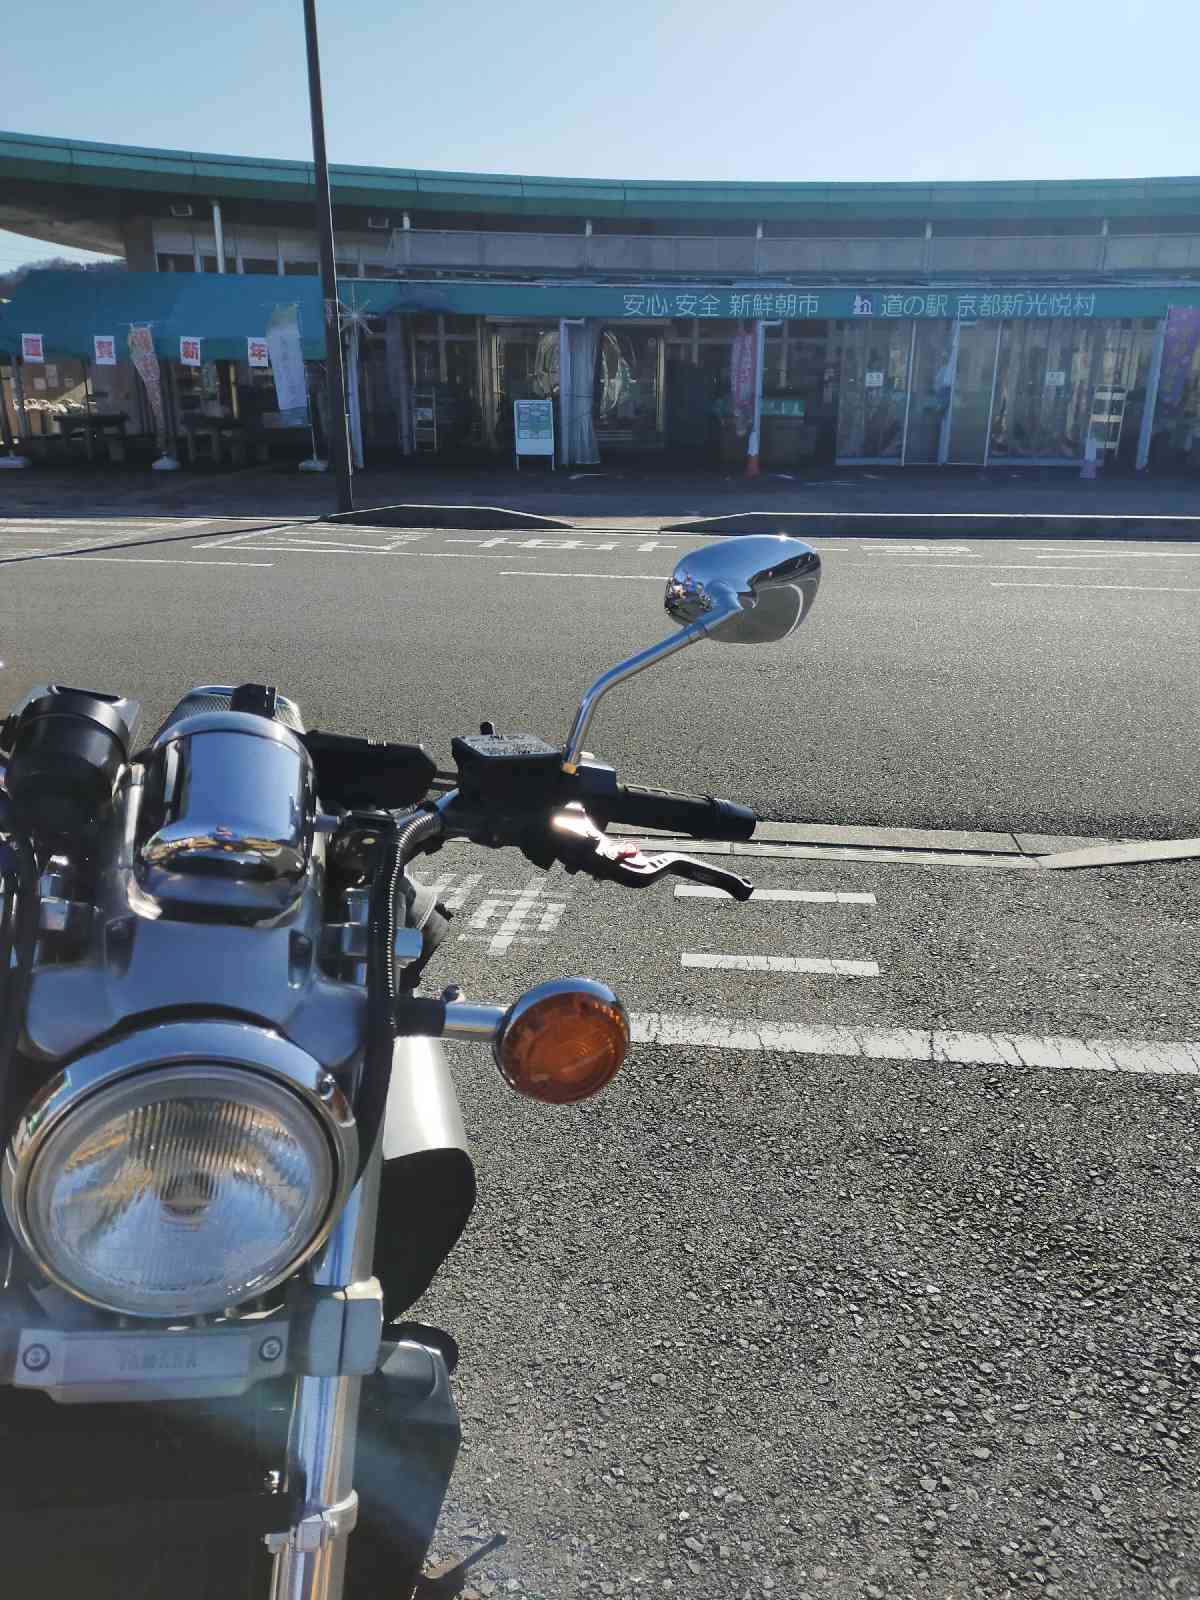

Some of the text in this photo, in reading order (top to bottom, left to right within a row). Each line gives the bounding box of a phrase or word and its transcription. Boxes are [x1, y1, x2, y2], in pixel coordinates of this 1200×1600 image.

[728, 293, 820, 317] 新鮮朝市
[880, 292, 1096, 317] 道の駅 京都新光悦村
